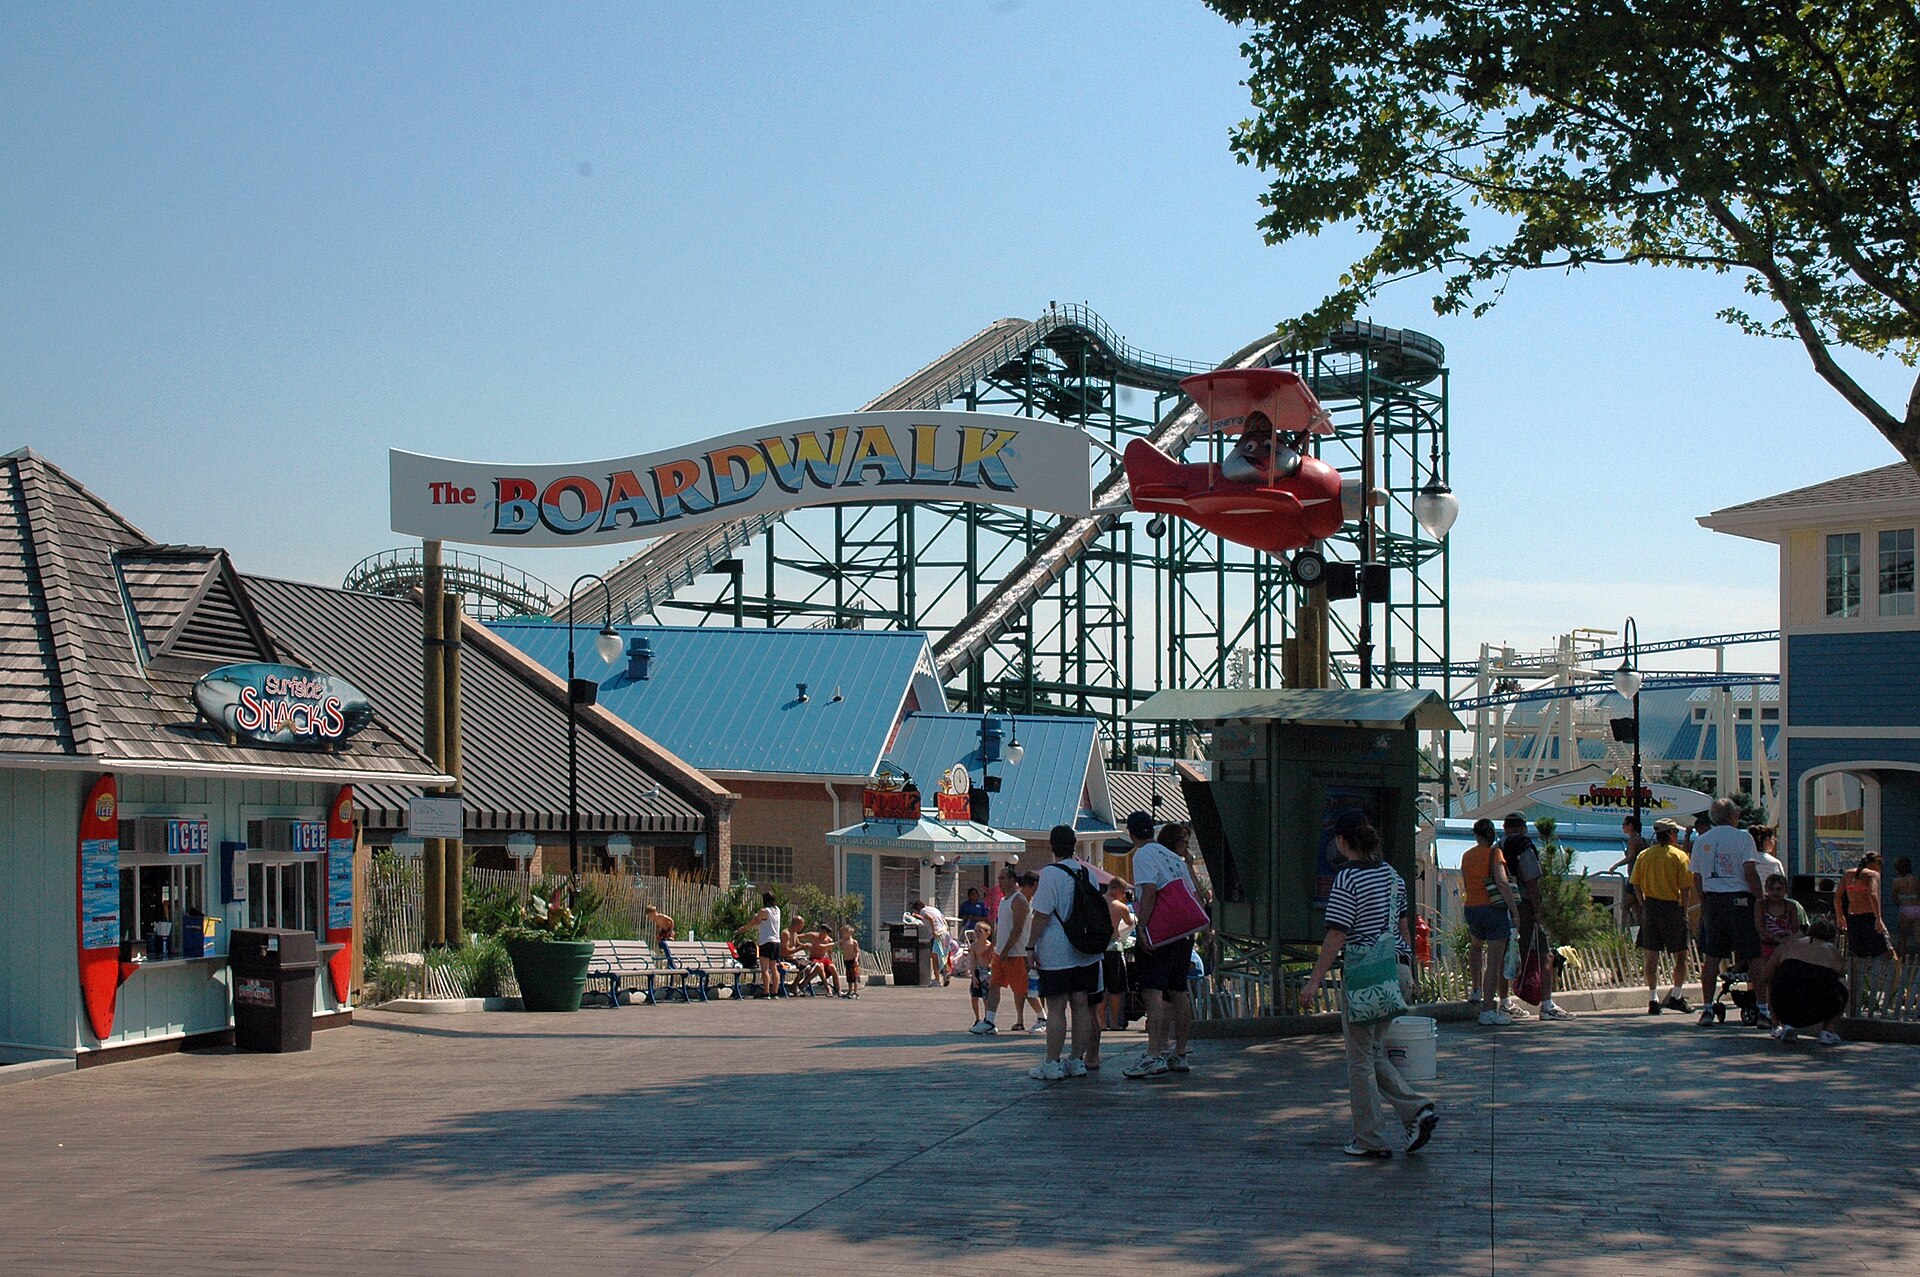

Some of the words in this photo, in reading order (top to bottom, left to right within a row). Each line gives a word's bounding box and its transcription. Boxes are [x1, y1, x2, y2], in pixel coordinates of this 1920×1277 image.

[428, 481, 476, 505] The
[490, 424, 1018, 535] BOARDWALK
[266, 674, 323, 700] Surfside
[236, 686, 345, 737] SNACKS
[1579, 794, 1662, 809] POPCORN
[1592, 807, 1650, 816] sweet-n-sty
[172, 823, 208, 850] ICEE
[296, 824, 326, 849] ICEE
[853, 838, 882, 846] WEIGHT
[887, 840, 924, 849] BIRTHDAY
